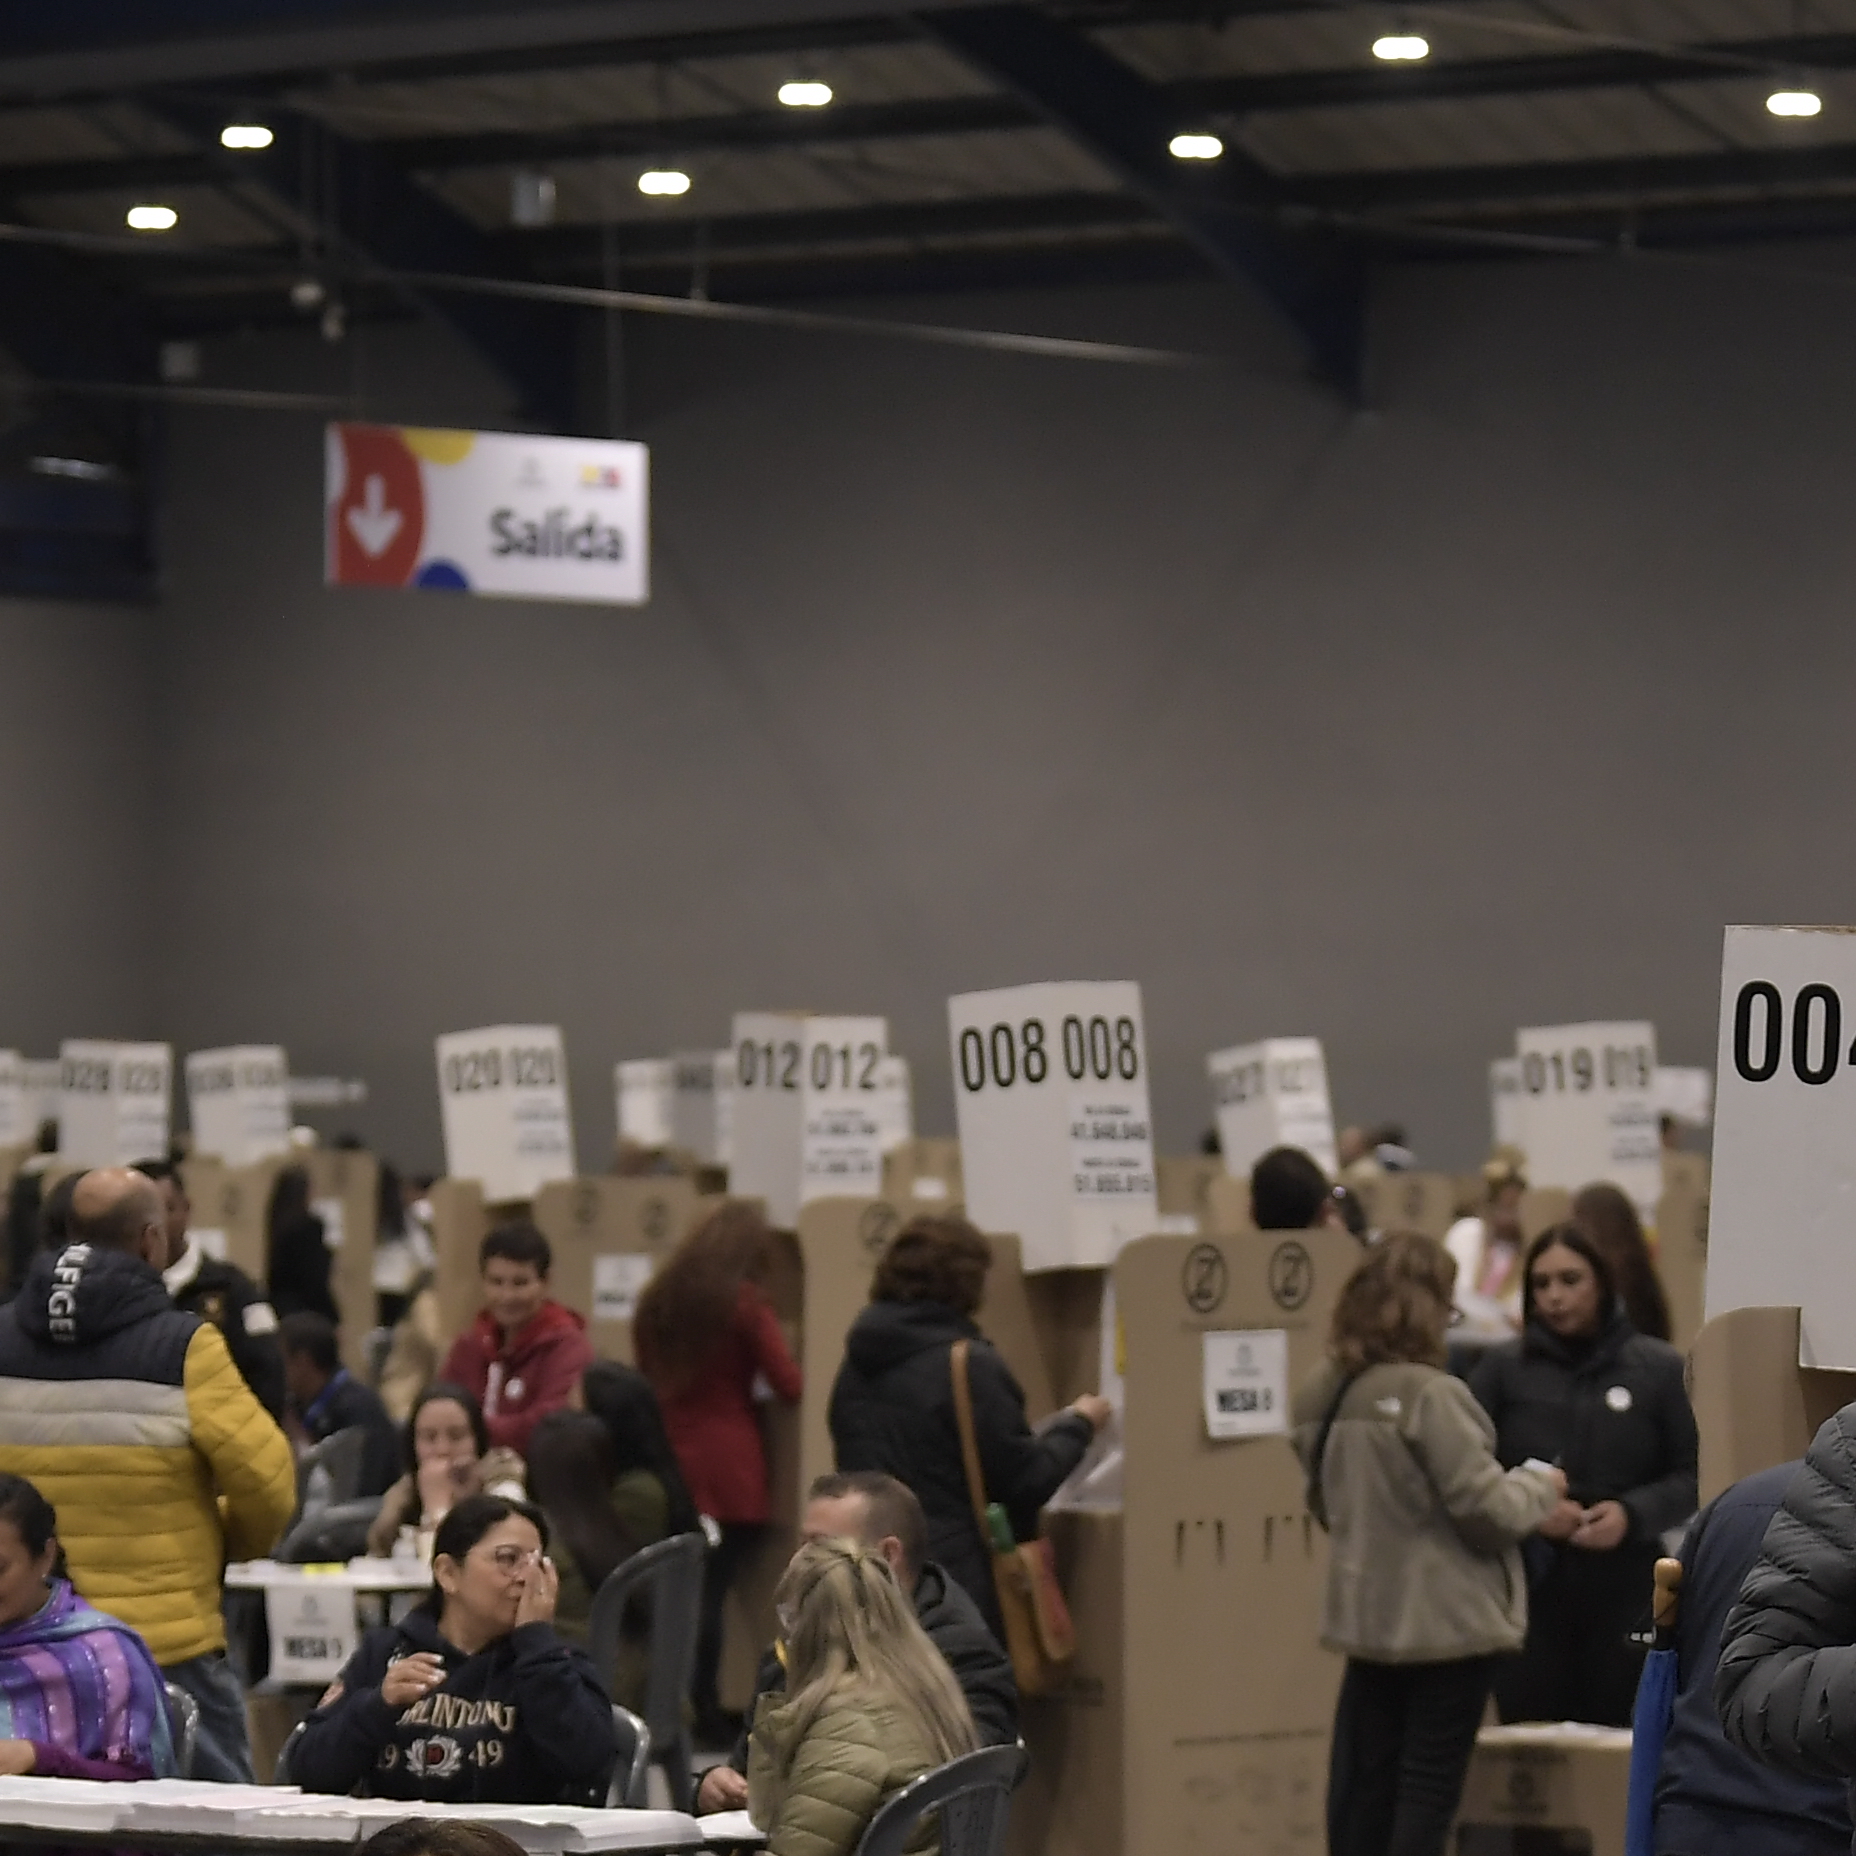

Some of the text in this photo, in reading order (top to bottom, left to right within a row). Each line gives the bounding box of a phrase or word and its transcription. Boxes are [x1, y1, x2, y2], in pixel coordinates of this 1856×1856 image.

[491, 506, 625, 560] Salida
[738, 1038, 799, 1089] 012
[812, 1042, 878, 1090] 012
[960, 1026, 1047, 1091] 008
[1063, 1014, 1137, 1080] 008
[1524, 1048, 1592, 1094] 019
